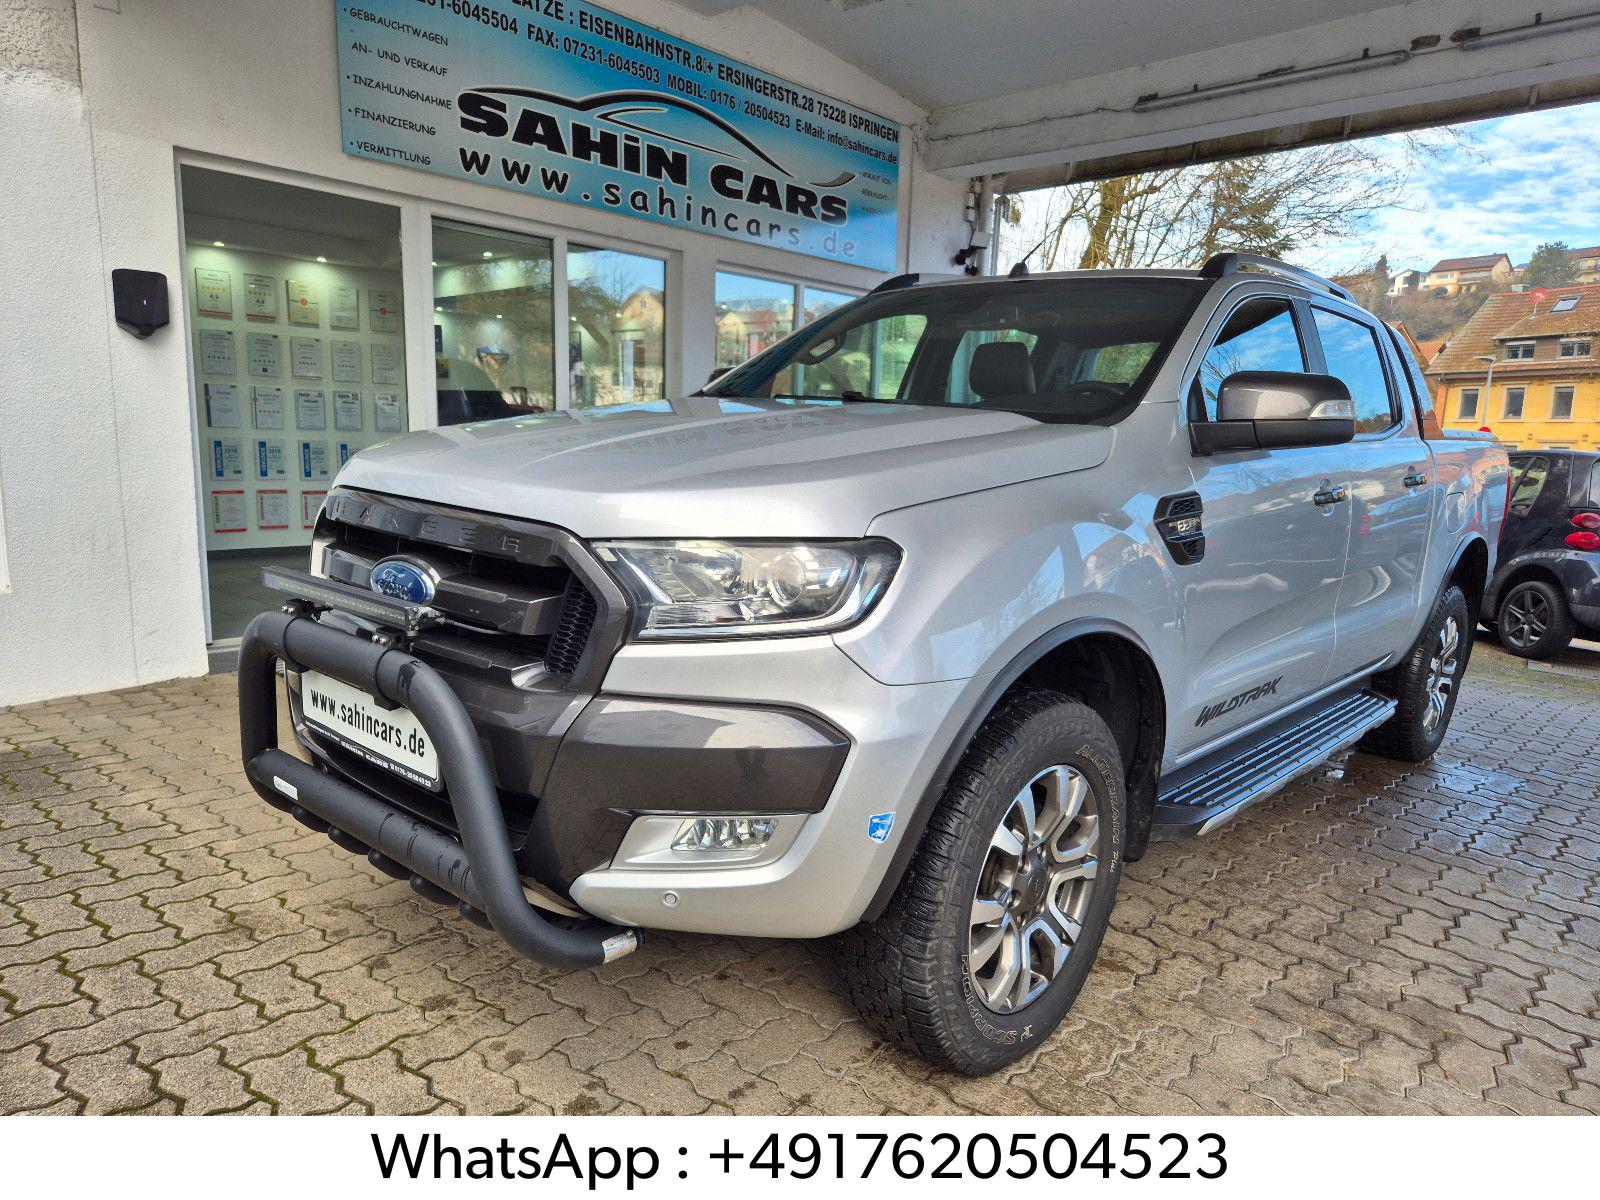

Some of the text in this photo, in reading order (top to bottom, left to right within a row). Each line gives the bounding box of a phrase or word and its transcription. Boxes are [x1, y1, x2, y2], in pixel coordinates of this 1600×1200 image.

[349, 7, 449, 46] GEBRAUCHTWAGEN
[351, 41, 448, 77] AN- UND VERKAUF
[352, 75, 452, 110] INZAHLUNGNAHME
[416, 0, 519, 35] 1-6045504
[527, 23, 559, 49] FAX:
[563, 36, 660, 83] 07231-6045503
[667, 73, 706, 100] MOBIL:
[710, 89, 736, 109] 0176
[744, 100, 790, 128] 20504523
[795, 118, 825, 140] E-Mail:
[827, 129, 897, 164] info@sahincars.de
[718, 62, 814, 112] ERSINGERSTR.28
[817, 100, 846, 124] 75228
[849, 112, 899, 143] ISPRINGEN
[354, 107, 436, 136] FINANZIERUNG
[356, 141, 432, 166] VERMITTLUNG
[710, 164, 848, 226] CARS
[310, 688, 425, 758] www.sahincars.de
[1194, 675, 1284, 727] WILDTRAK
